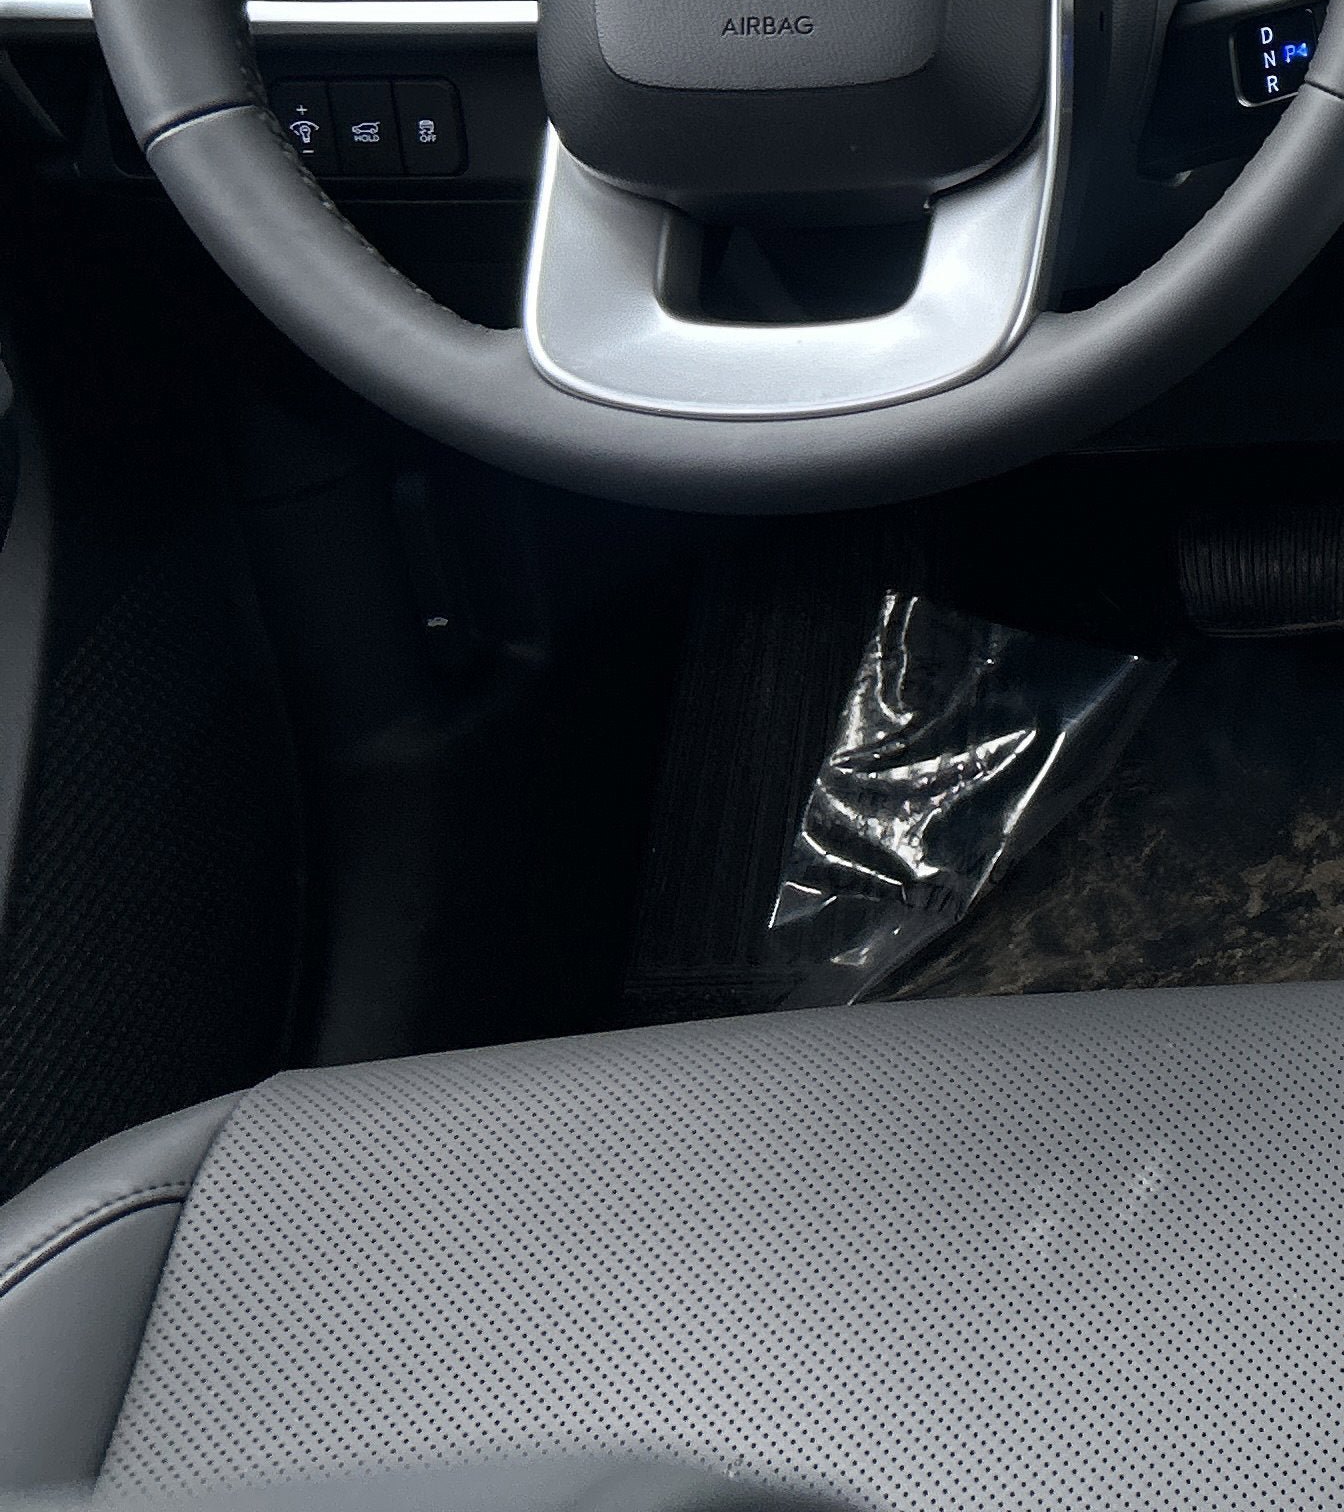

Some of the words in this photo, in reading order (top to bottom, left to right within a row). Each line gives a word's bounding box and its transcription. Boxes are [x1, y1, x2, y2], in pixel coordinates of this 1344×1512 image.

[721, 15, 815, 37] AIRBAG
[1260, 26, 1273, 45] D
[1263, 50, 1276, 69] N
[1284, 45, 1296, 63] P
[1266, 75, 1280, 94] R
[354, 134, 380, 143] HOLD
[419, 134, 437, 143] OFF
